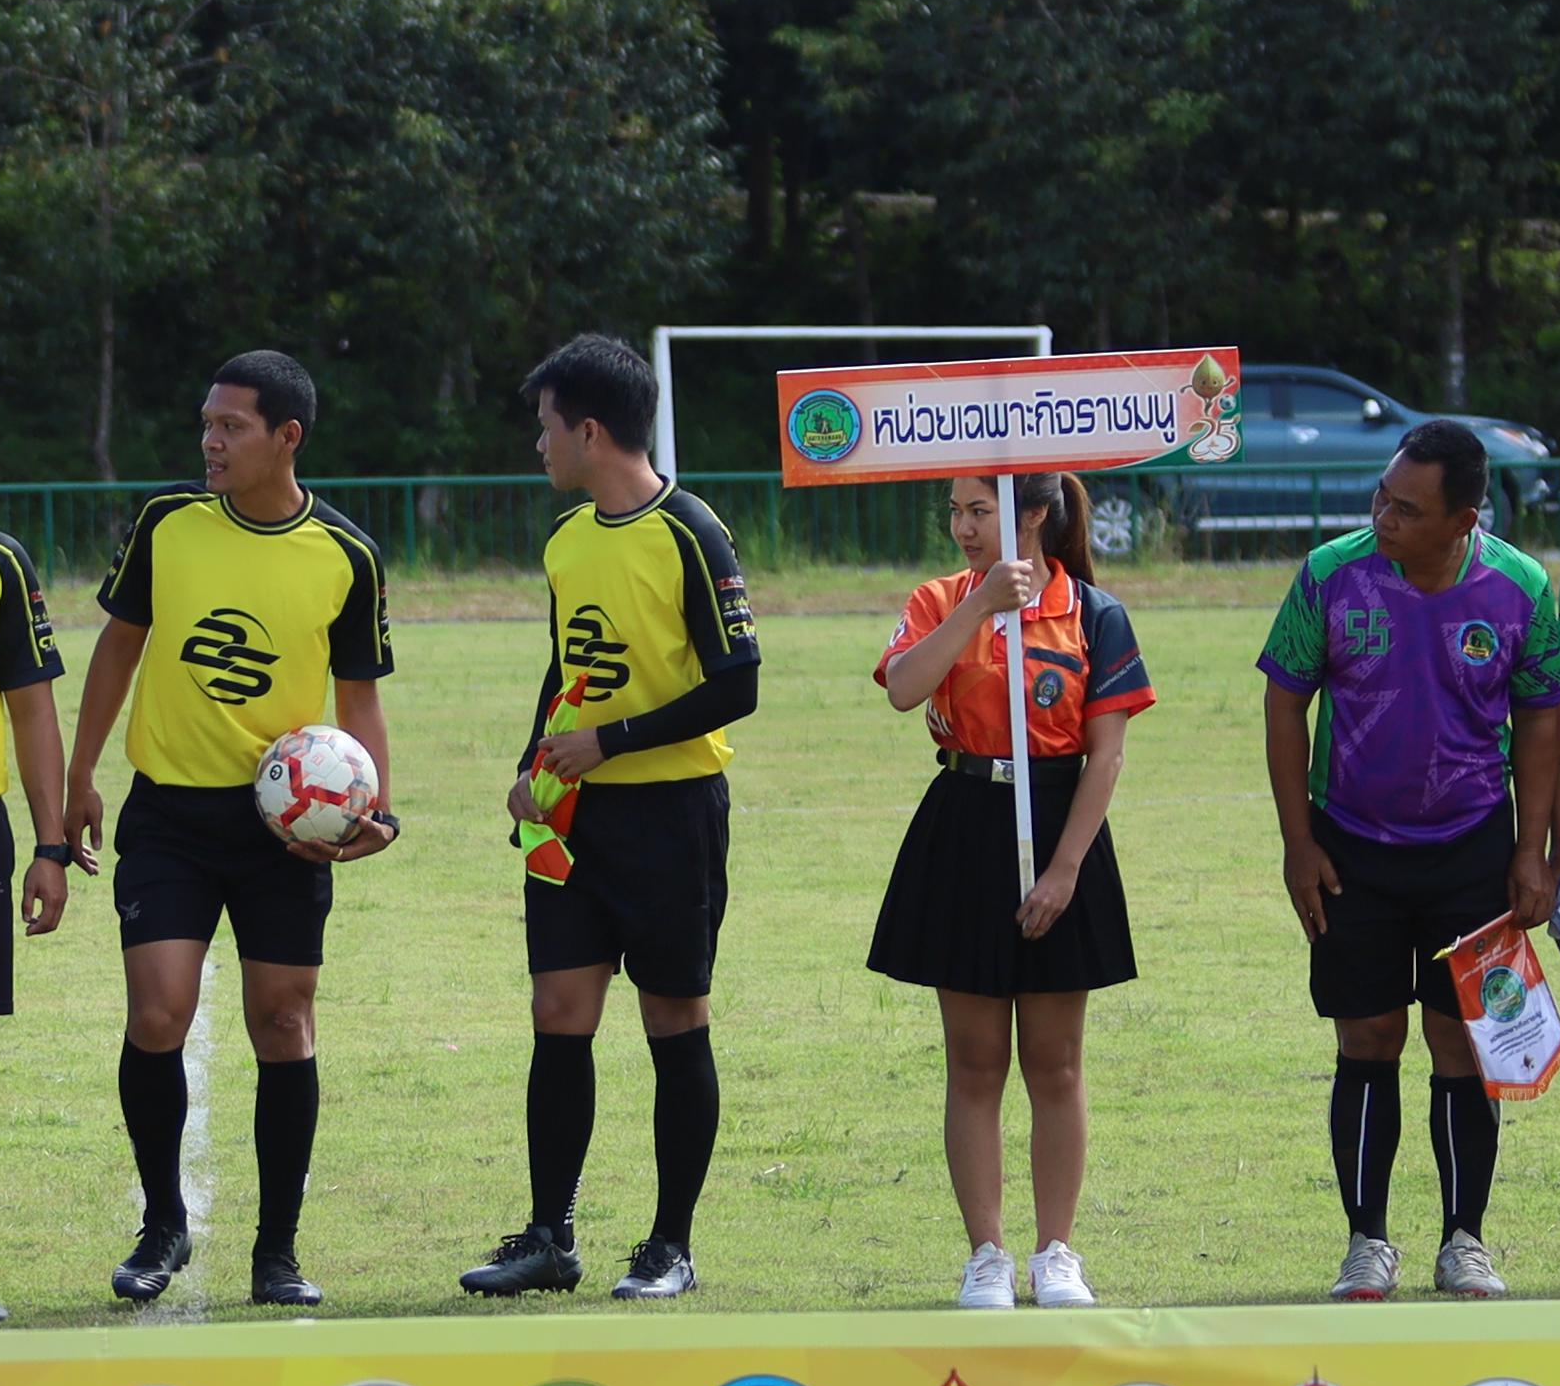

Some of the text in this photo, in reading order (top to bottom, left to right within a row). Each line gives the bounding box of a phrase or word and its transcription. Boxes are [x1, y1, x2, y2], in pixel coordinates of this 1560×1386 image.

[872, 390, 1177, 446] หน่วยเฉพาะกิจราชมนู
[1344, 609, 1391, 655] 55
